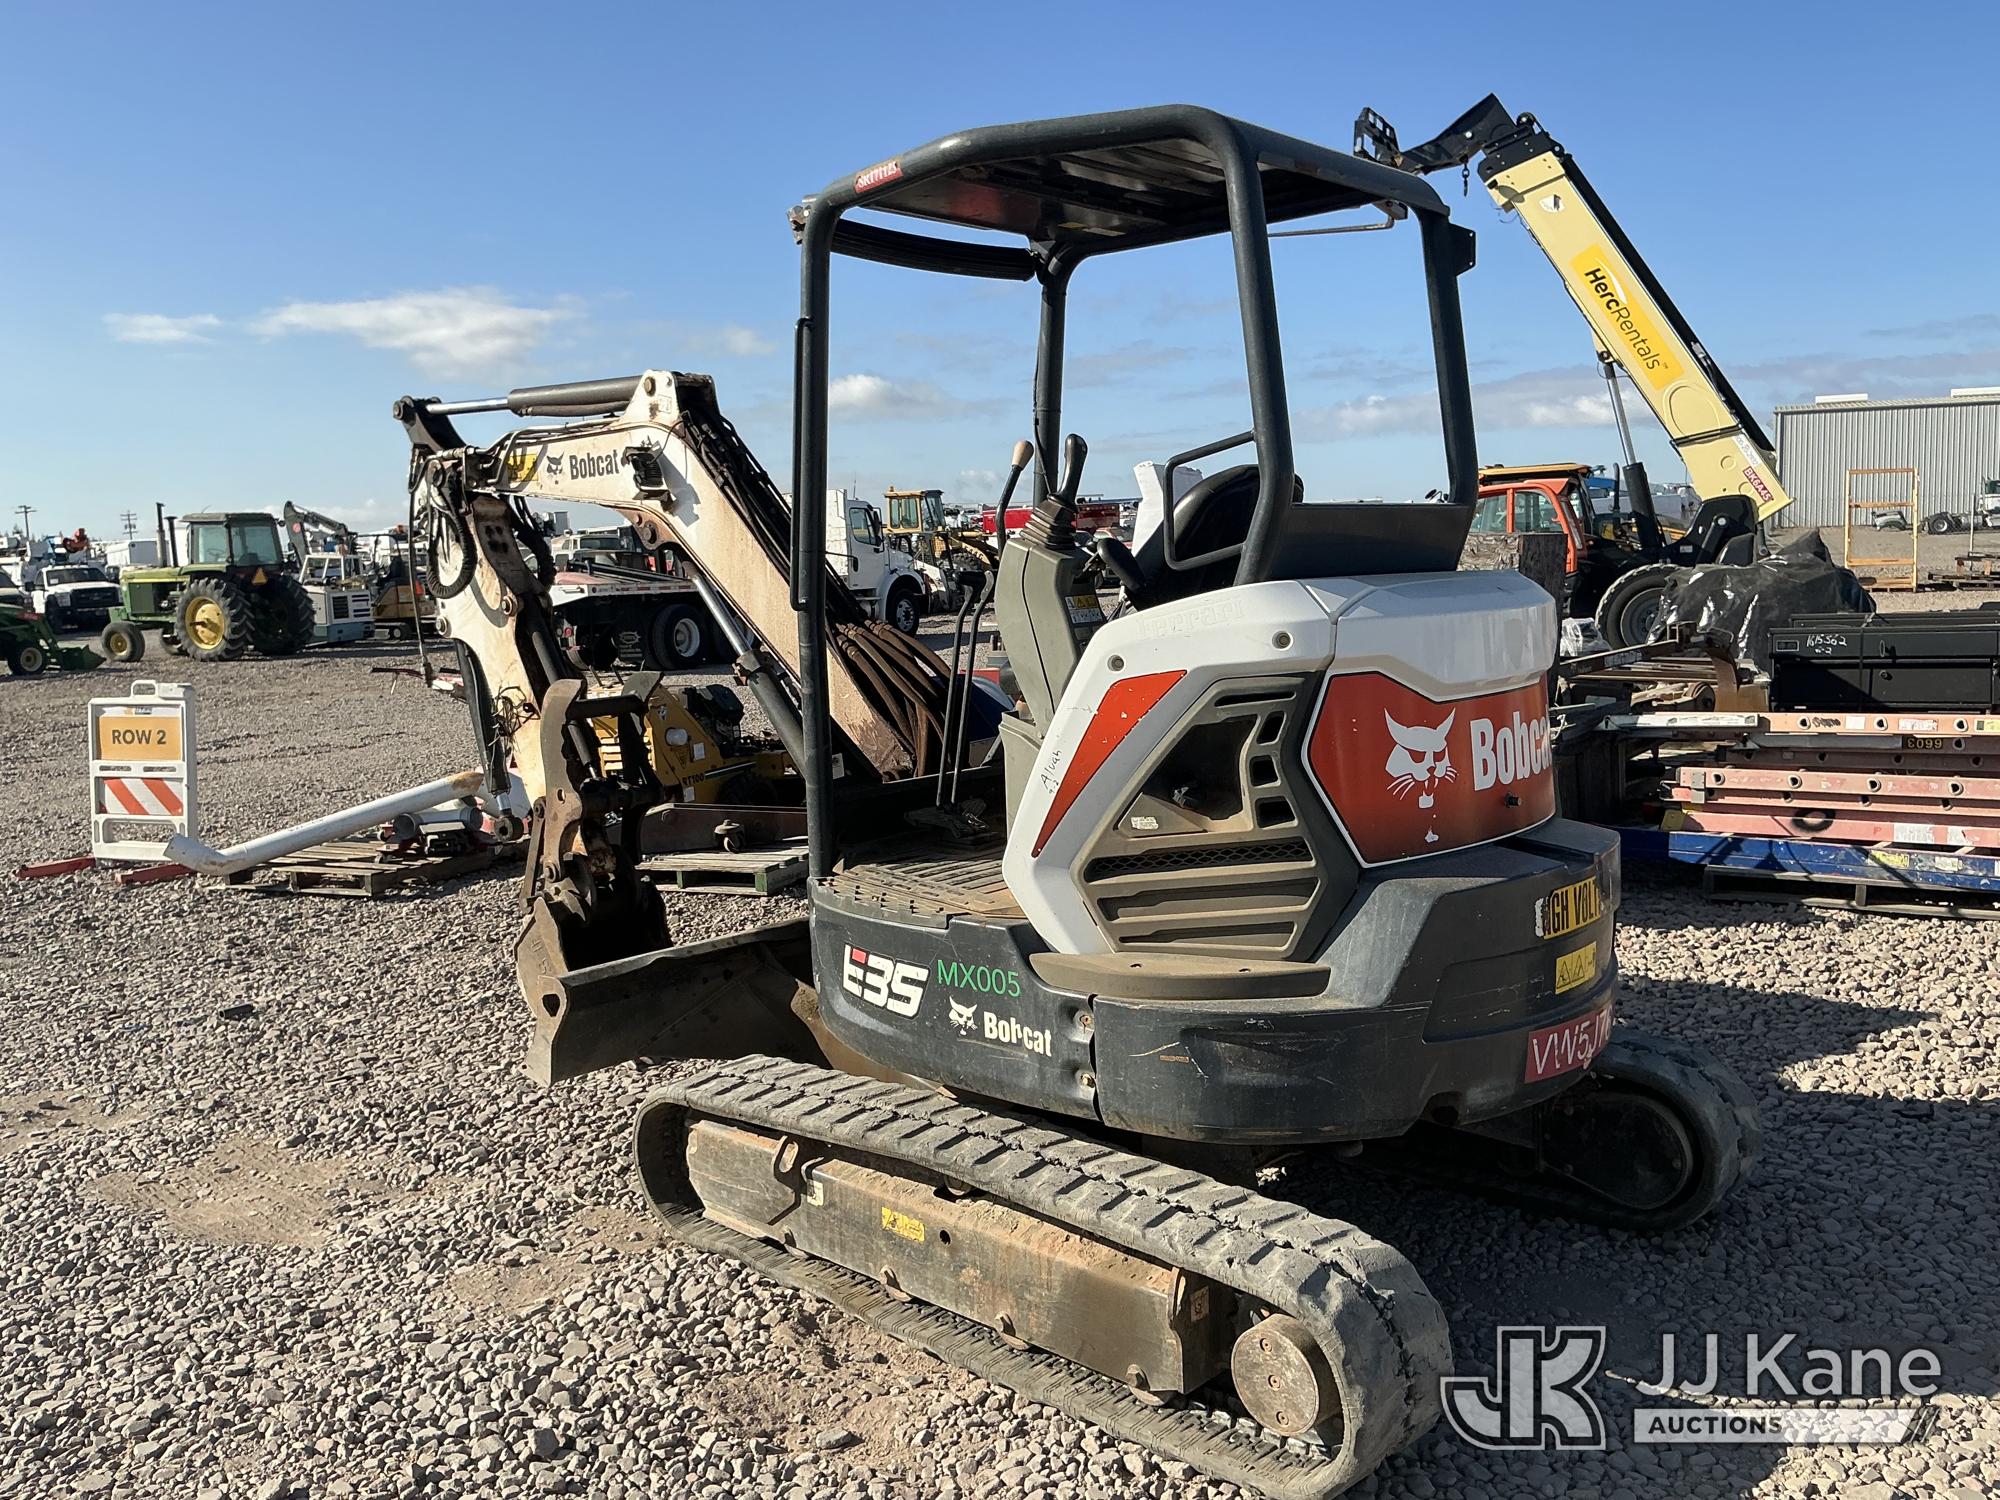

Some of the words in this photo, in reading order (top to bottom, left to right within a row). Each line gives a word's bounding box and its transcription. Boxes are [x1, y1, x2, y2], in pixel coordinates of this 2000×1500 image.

[1584, 267, 1660, 370] HercRentals
[569, 449, 620, 480] Bobcat
[112, 729, 152, 744] ROW
[156, 729, 166, 744] 2
[937, 959, 1021, 997] MX005
[983, 1011, 1052, 1057] Bobcat
